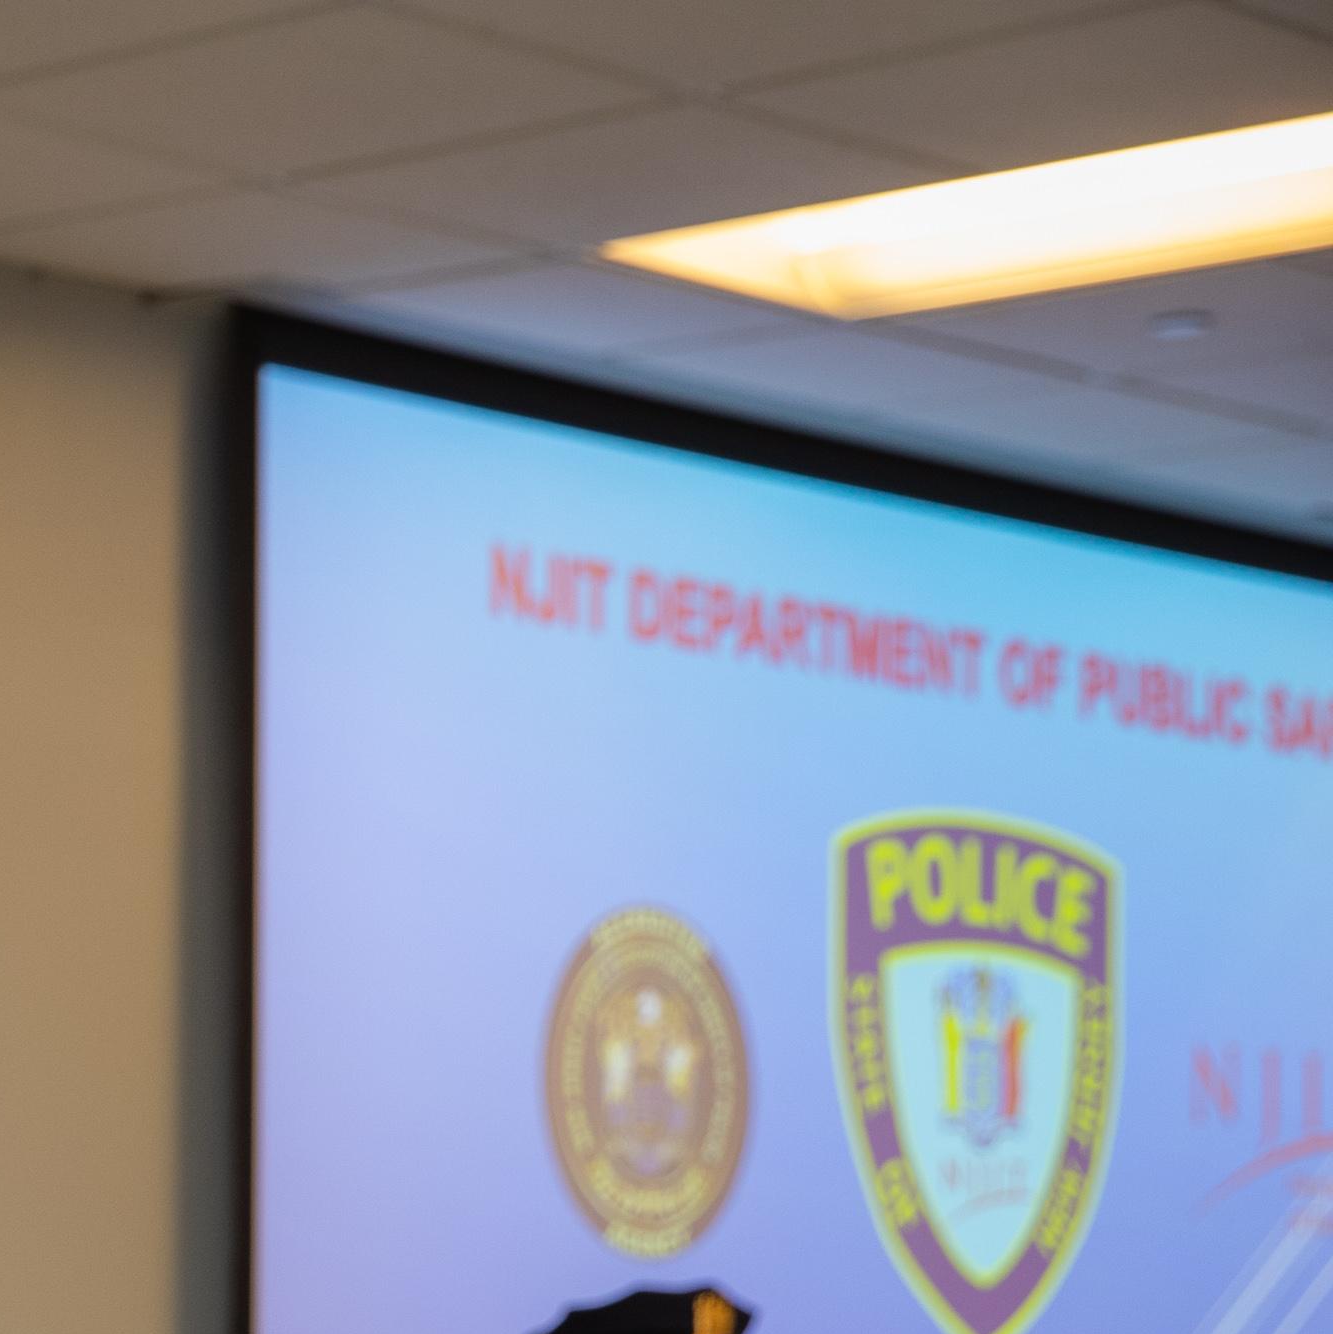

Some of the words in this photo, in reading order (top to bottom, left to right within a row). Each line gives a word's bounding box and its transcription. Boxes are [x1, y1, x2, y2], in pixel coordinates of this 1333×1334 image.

[488, 542, 613, 636] NJIT
[627, 564, 988, 704] DEPARTMENT
[997, 634, 1065, 713] OF
[1076, 648, 1251, 748] PUBLIC
[1263, 683, 1333, 765] SA
[864, 830, 1098, 960] POLICE
